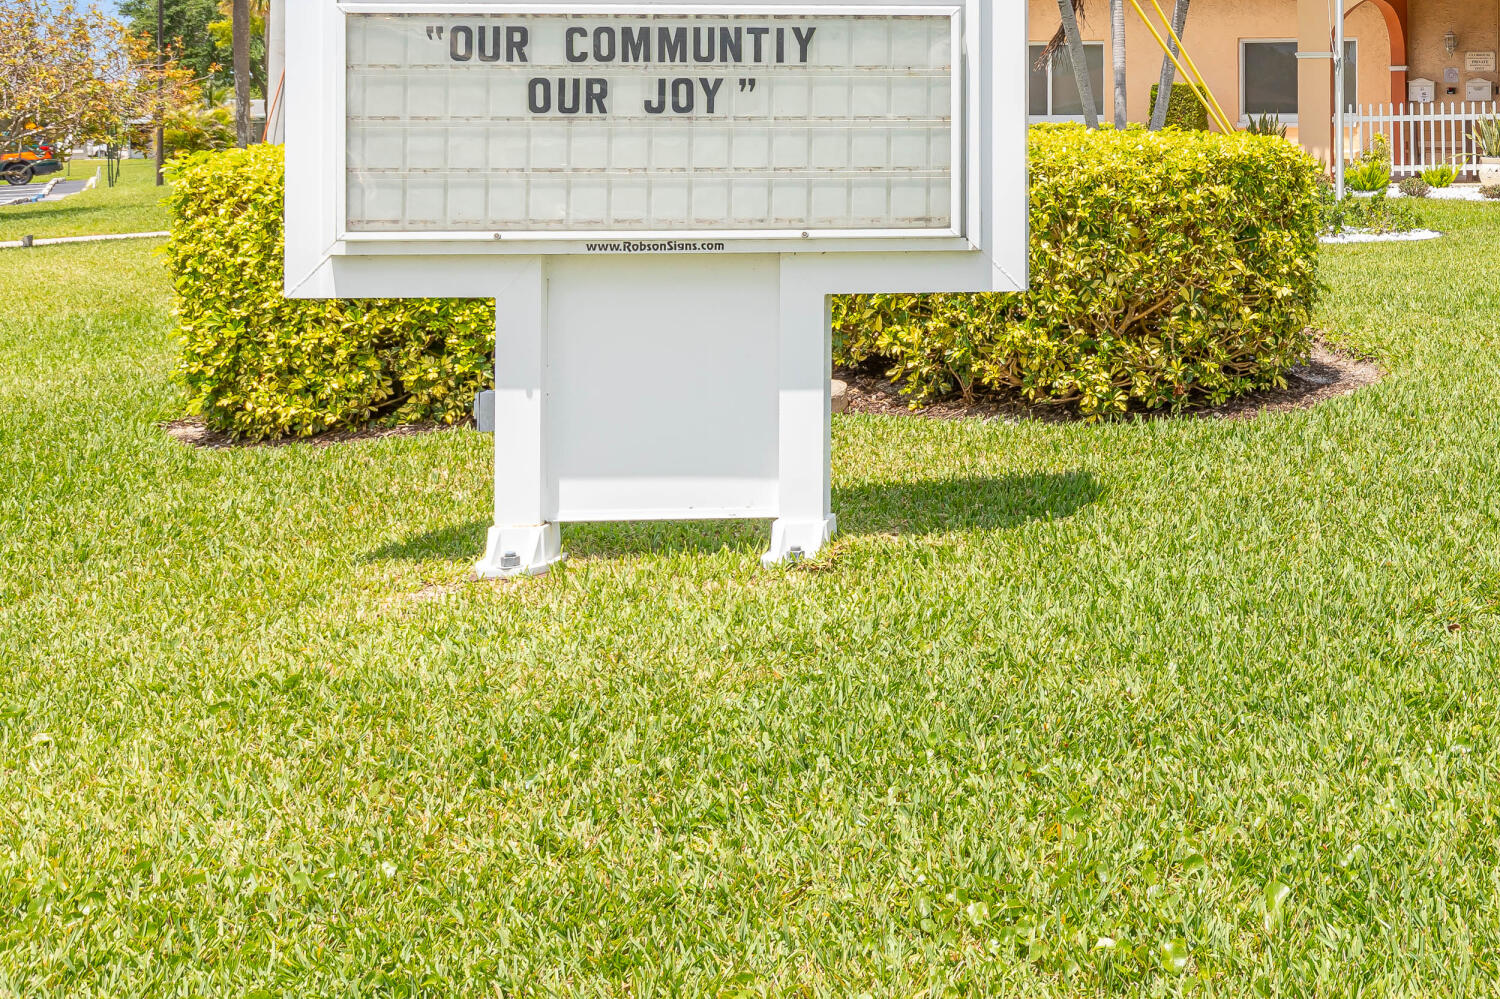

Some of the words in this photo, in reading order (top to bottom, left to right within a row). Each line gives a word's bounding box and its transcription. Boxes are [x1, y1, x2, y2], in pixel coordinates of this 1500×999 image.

[565, 26, 817, 64] COMMUNTIY
[527, 77, 608, 114] OUR
[586, 240, 725, 252] www.RobsonSigns.com
